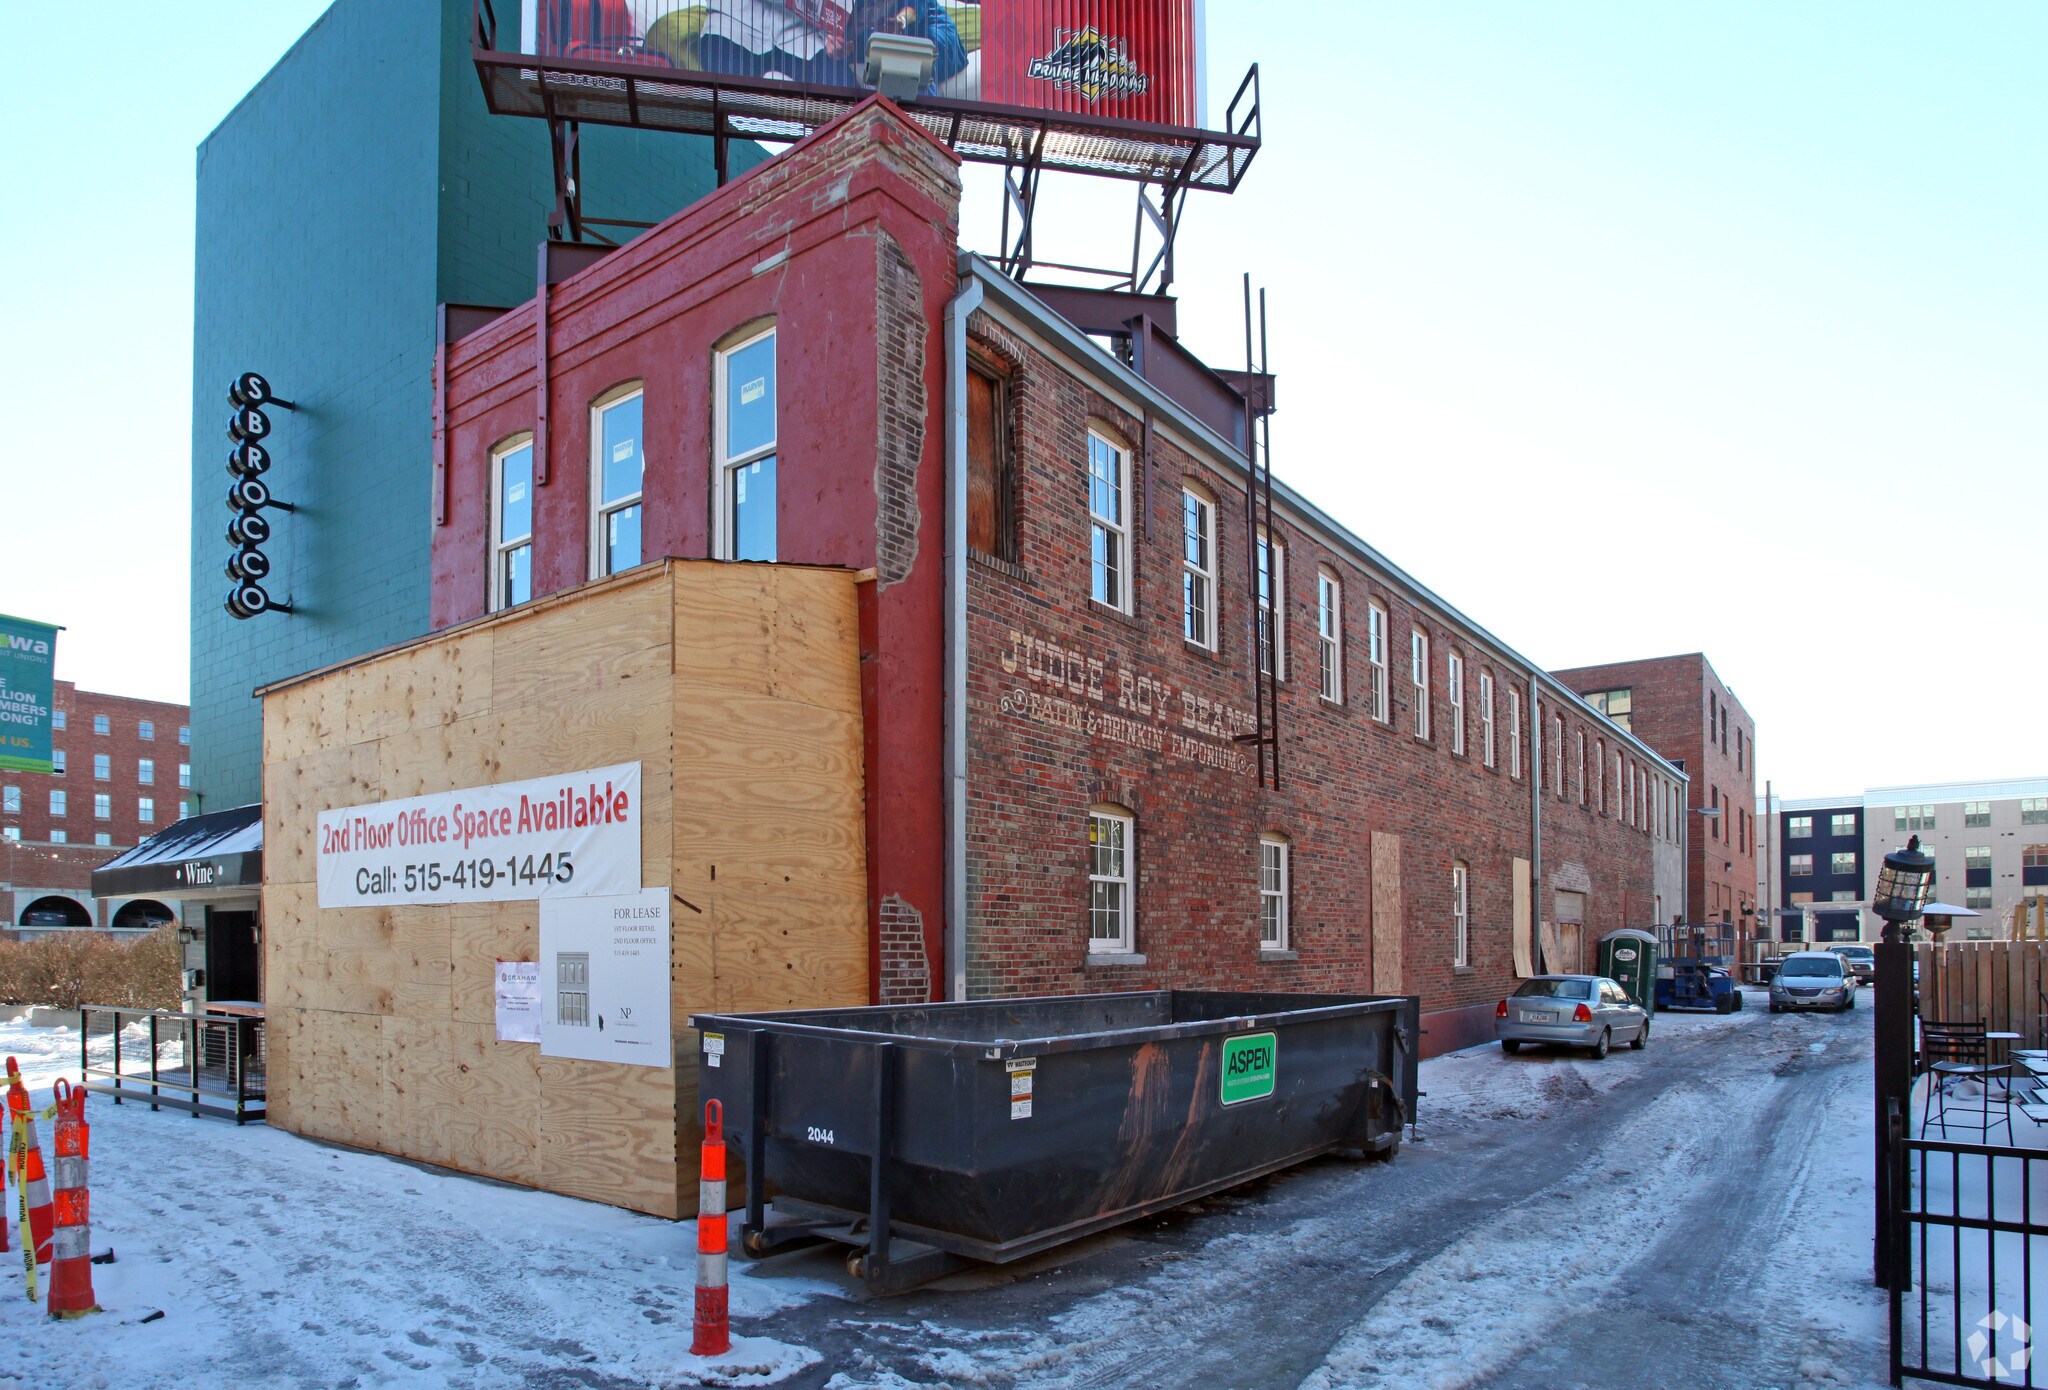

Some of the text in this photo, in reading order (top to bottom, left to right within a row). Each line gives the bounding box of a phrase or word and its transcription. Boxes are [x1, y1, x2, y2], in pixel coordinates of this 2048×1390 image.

[1034, 63, 1079, 81] PRAIRIE
[742, 379, 764, 395] MARVIN
[241, 376, 266, 610] SBROCCO
[0, 633, 49, 655] wa
[14, 652, 48, 664] UNIONS
[1001, 630, 1104, 702] JUDGE
[1117, 668, 1171, 720] ROY
[0, 689, 36, 704] LION
[0, 701, 47, 716] MBERS
[0, 711, 38, 726] ONG!
[1029, 692, 1237, 772] EATIN' & DRINKIN' EMPORIUM
[11, 736, 34, 749] US.
[322, 781, 629, 854] 2nd Floor Office Space Available
[185, 862, 213, 884] Wine
[356, 851, 574, 895] Call: 515-419-1445
[613, 907, 661, 919] FOR LEASE
[1228, 1046, 1271, 1075] ASPEN
[807, 1126, 834, 1144] 2044
